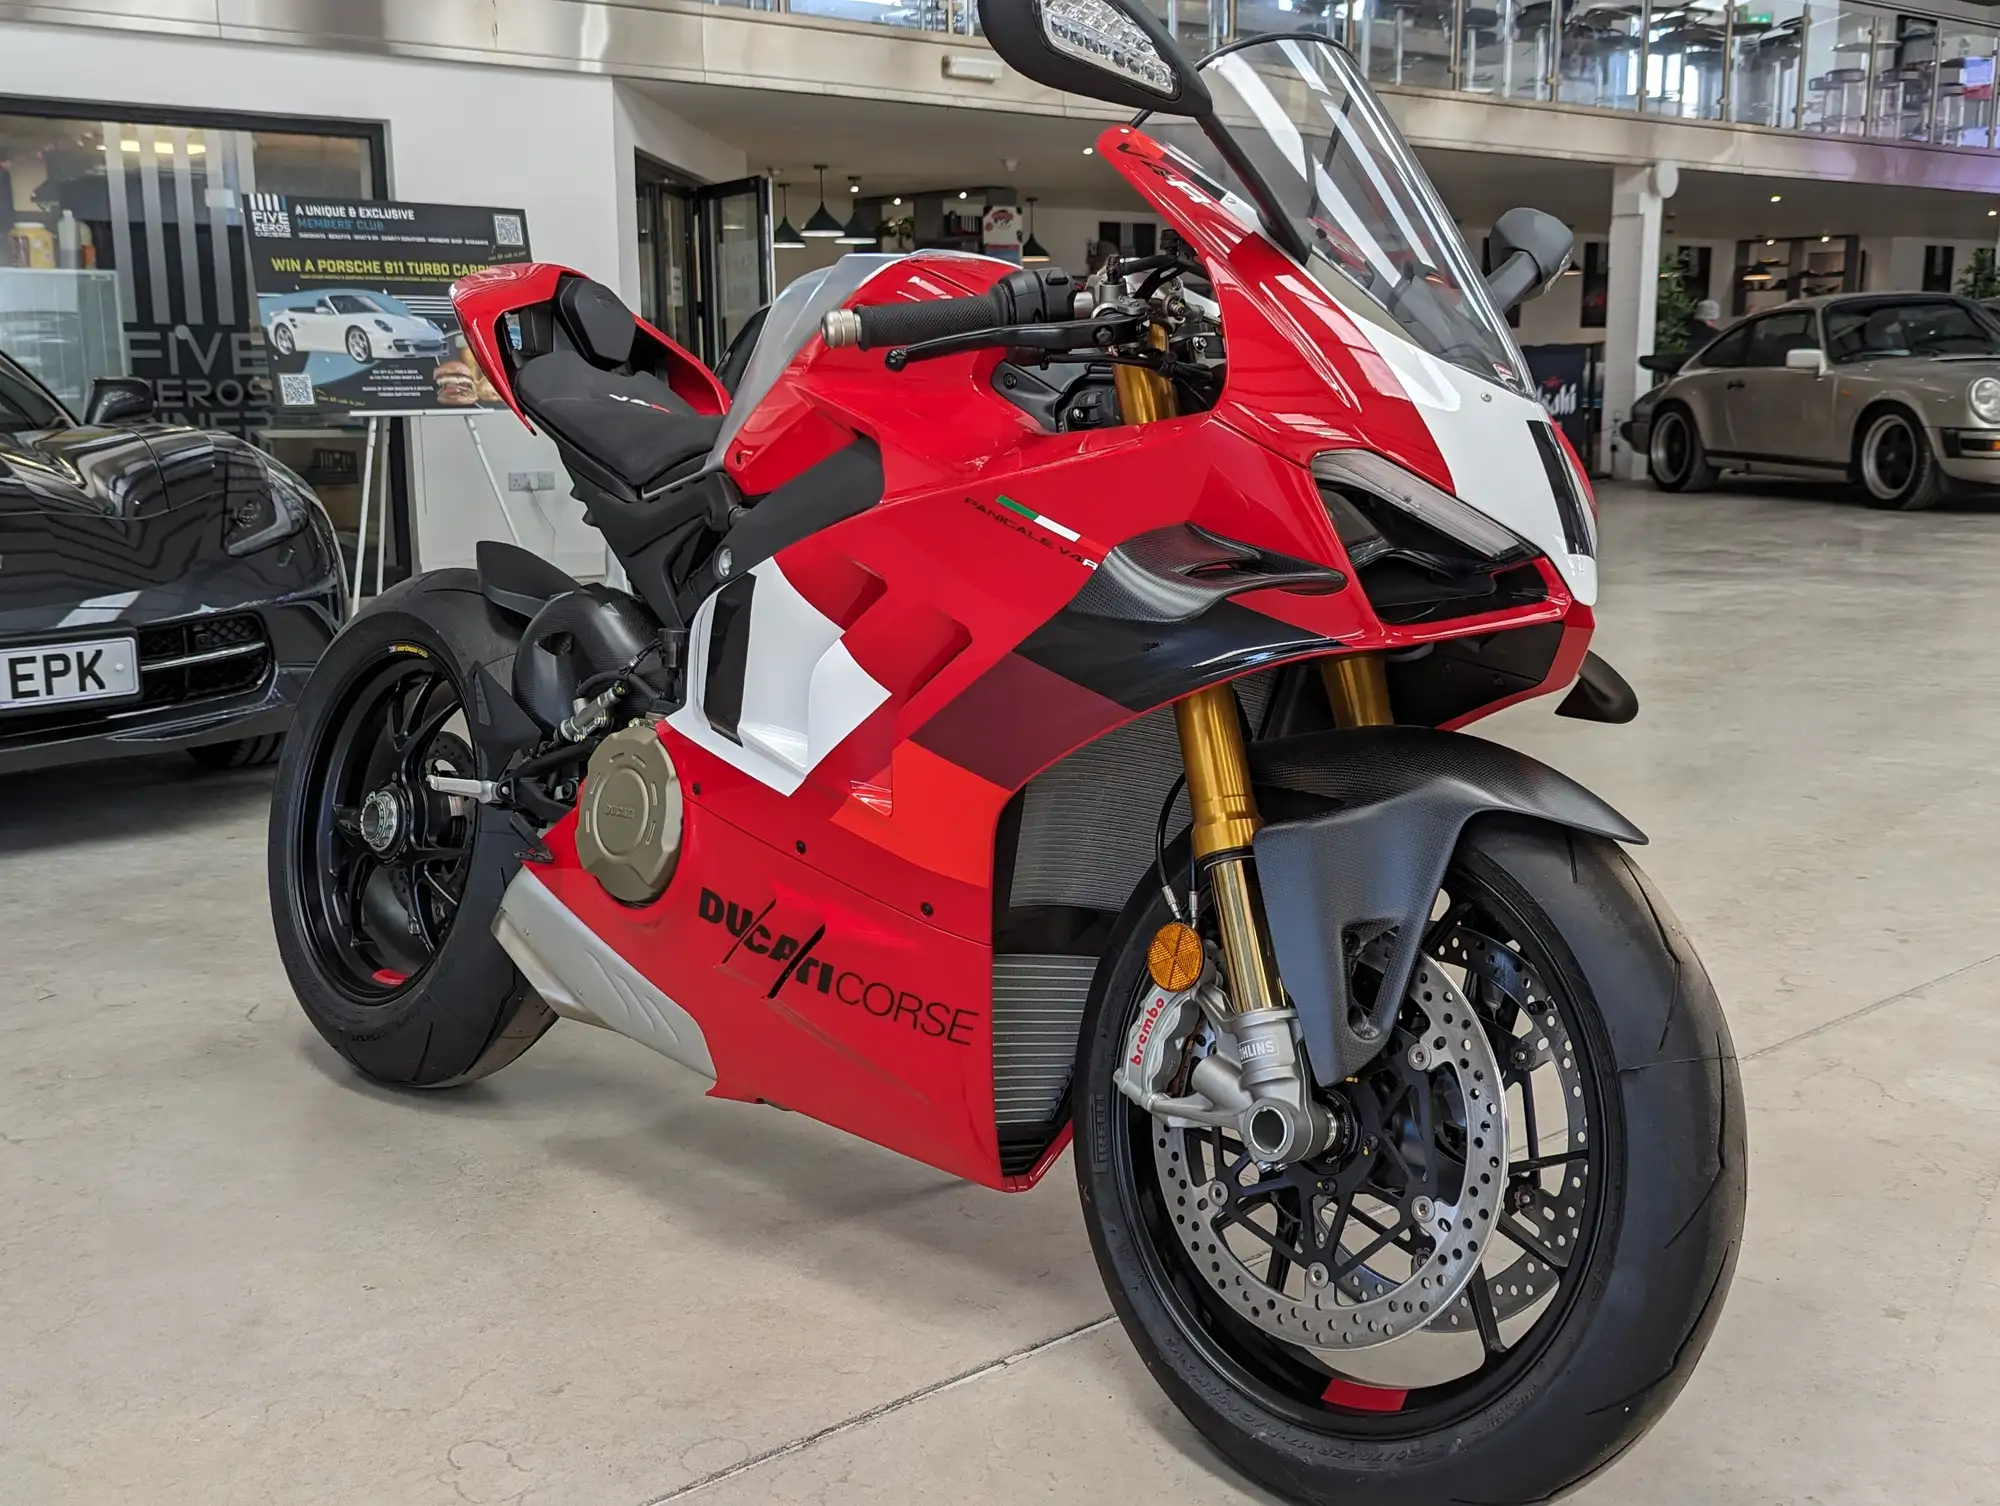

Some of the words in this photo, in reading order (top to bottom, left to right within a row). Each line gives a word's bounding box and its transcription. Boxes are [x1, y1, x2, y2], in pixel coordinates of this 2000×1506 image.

[251, 211, 290, 224] FIVE
[295, 204, 303, 216] A
[305, 205, 346, 218] UNIQUE
[359, 207, 415, 220] EXCLUSIVE
[254, 223, 292, 233] ZEROS
[356, 220, 385, 231] CLUB
[271, 257, 302, 272] WIN
[304, 258, 316, 272] A
[317, 259, 382, 274] PORSCHE
[384, 261, 405, 274] 911
[406, 261, 450, 276] TURBO
[123, 331, 269, 376] FIVE
[150, 379, 273, 407] EROS
[7, 649, 107, 700] EPK
[698, 886, 835, 999] DUCATI
[835, 971, 980, 1047] CORSE
[1129, 997, 1165, 1067] brembo
